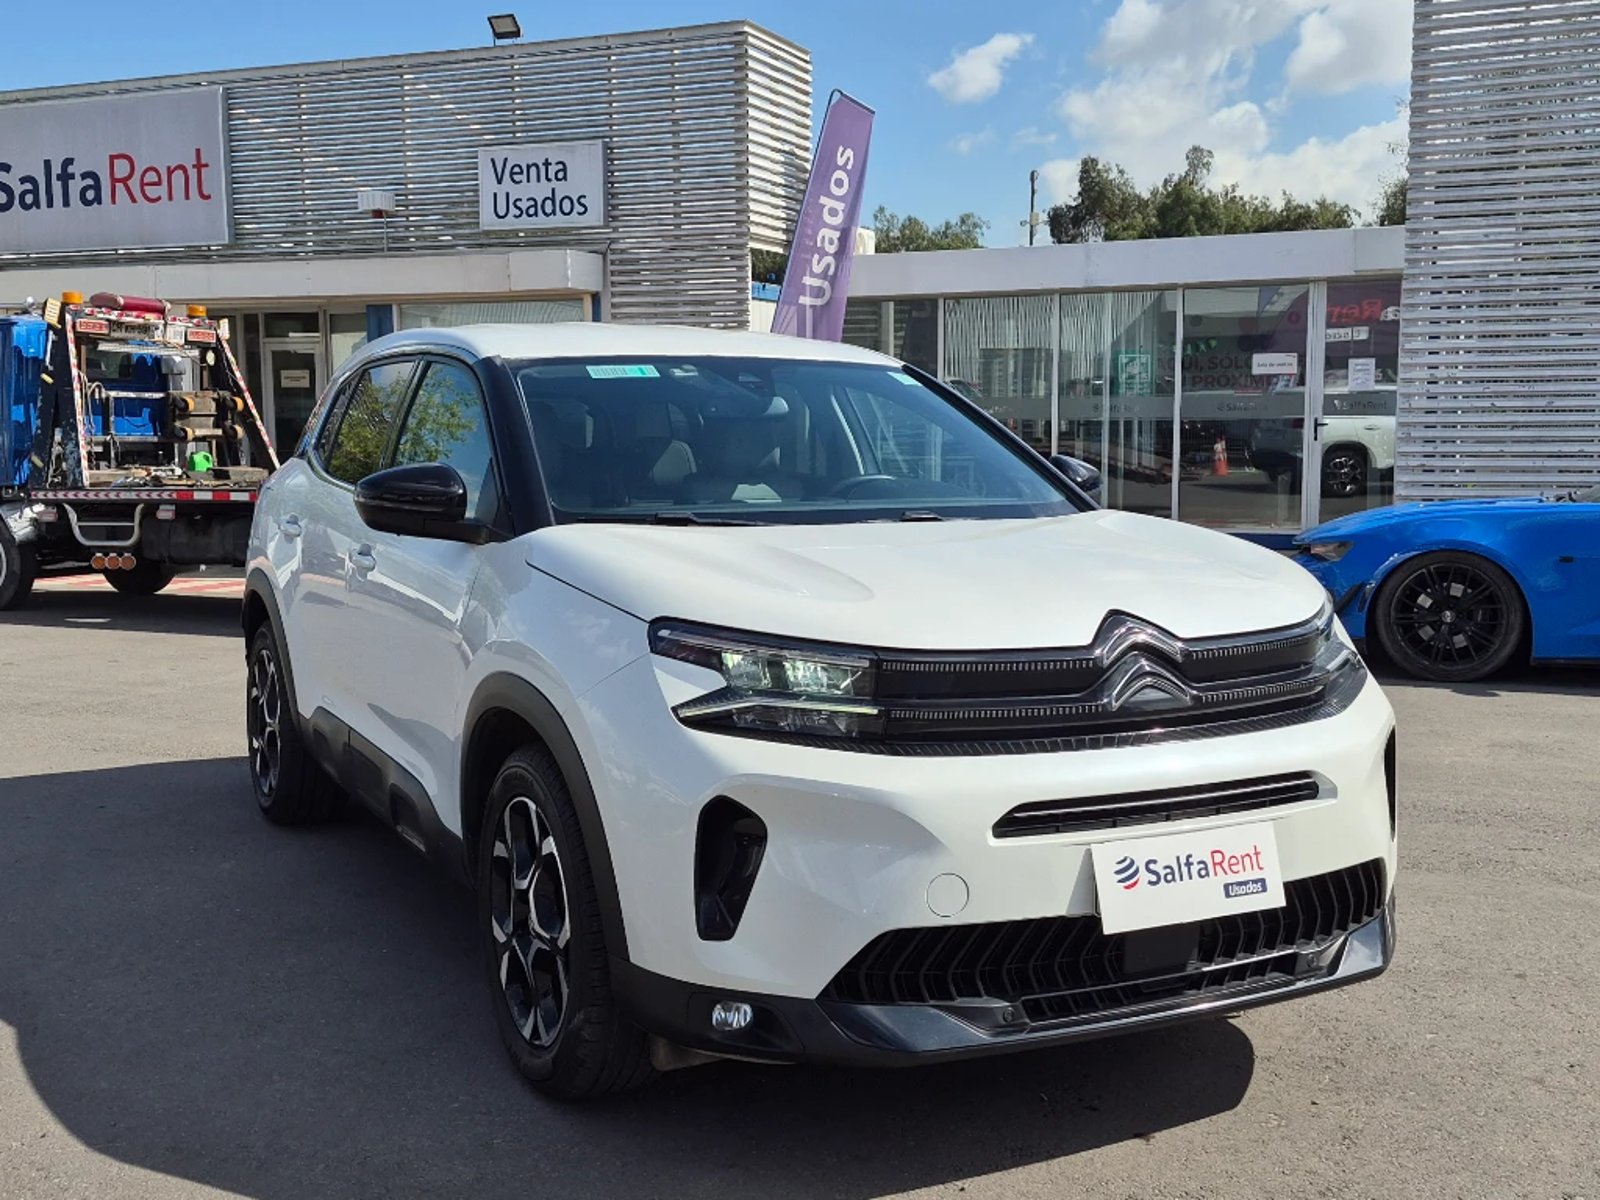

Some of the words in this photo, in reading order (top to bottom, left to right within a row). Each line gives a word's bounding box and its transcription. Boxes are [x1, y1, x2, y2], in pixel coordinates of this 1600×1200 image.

[0, 148, 212, 213] SalfaRent
[490, 156, 568, 184] Venta
[492, 187, 589, 220] Usados
[799, 145, 854, 307] Usados
[1144, 845, 1264, 887] SalfaRent
[1228, 881, 1263, 896] Usados
